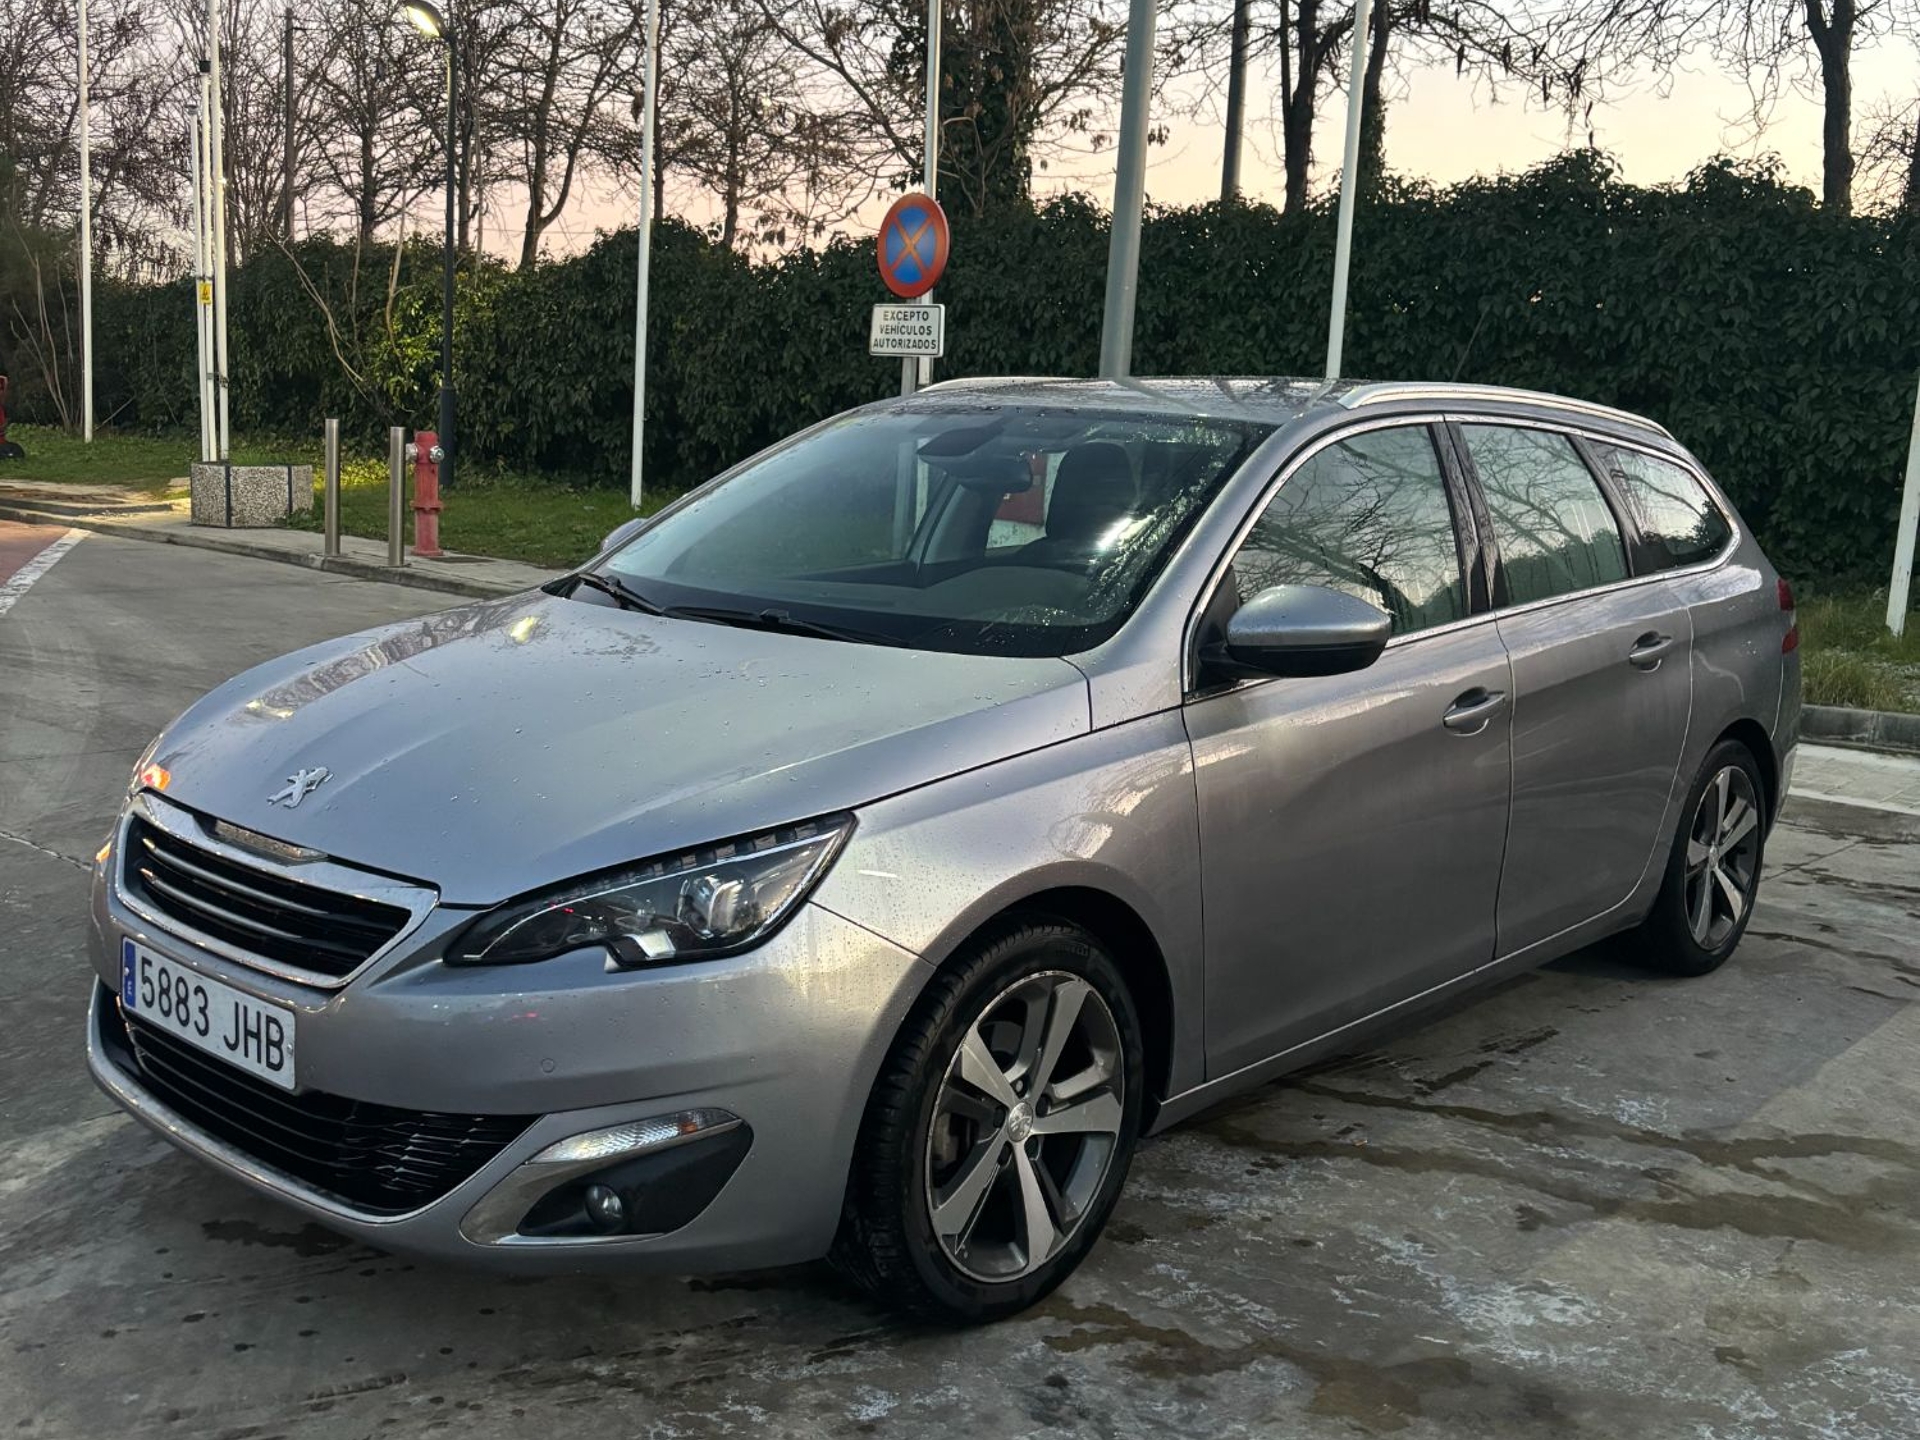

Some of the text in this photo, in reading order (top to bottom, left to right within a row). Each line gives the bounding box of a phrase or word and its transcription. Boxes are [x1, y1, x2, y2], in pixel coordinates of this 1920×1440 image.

[883, 310, 929, 321] EXCEPTO
[880, 322, 932, 336] VEHÍCULOS
[873, 338, 936, 350] AUTORIZADOS
[141, 956, 285, 1072] 5883 JHB
